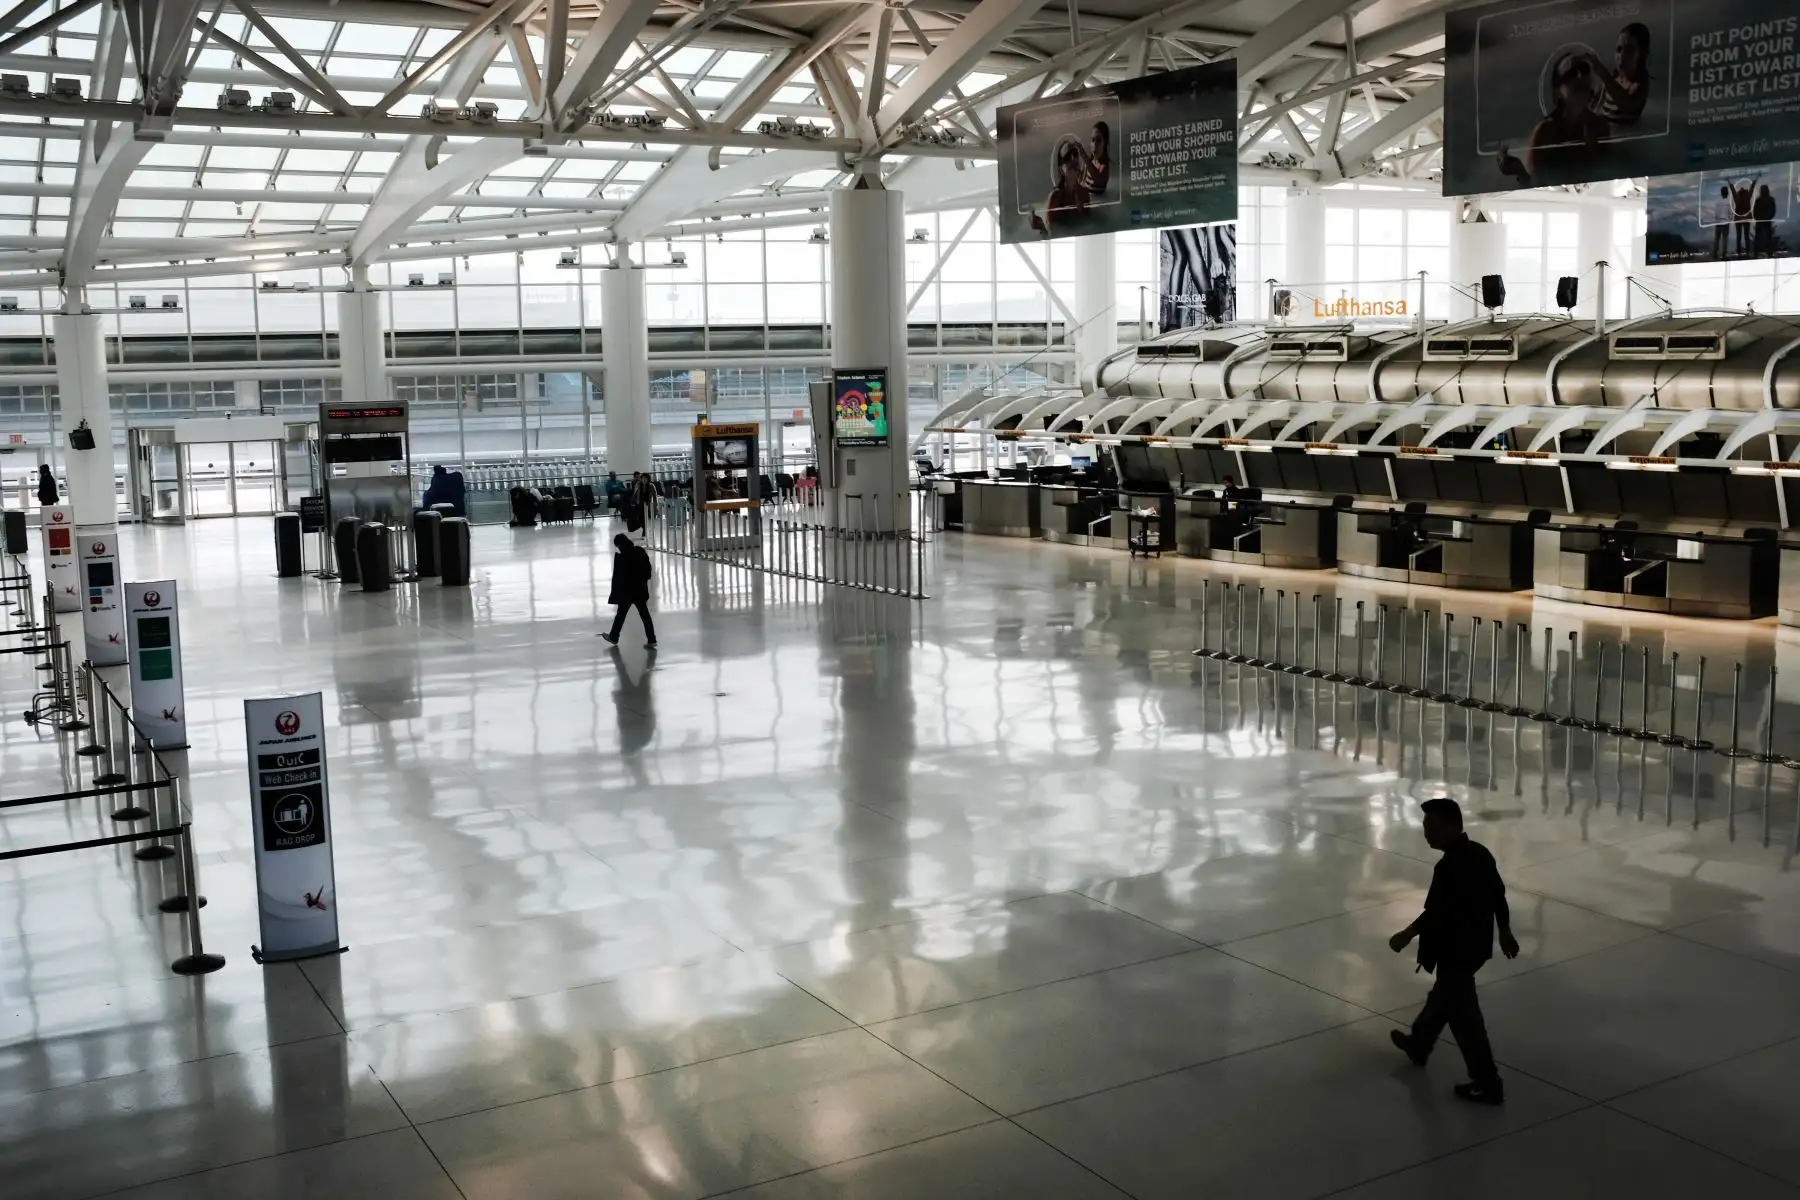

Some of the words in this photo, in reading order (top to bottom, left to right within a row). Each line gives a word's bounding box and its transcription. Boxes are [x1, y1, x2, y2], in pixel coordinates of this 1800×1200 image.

[1691, 30, 1724, 50] PUT
[1728, 16, 1798, 44] POINTS
[1690, 46, 1739, 68] FROM
[1744, 36, 1794, 58] YOUR
[1690, 65, 1727, 86] LIST
[1689, 79, 1758, 104] BUCKET
[1130, 131, 1148, 144] PUT
[1149, 125, 1183, 141] POINTS
[1185, 119, 1223, 135] EARNED
[1130, 144, 1155, 157] FROM
[1157, 139, 1182, 152] YOUR
[1184, 131, 1233, 148] SHOPPING
[1130, 157, 1149, 169] LIST
[1151, 151, 1189, 165] TOWARD
[1192, 147, 1217, 160] YOUR
[1130, 167, 1166, 181] BUCKET
[1167, 164, 1189, 176] LIST.
[1192, 293, 1207, 302] GAB
[1314, 297, 1407, 317] Lufthansa
[716, 426, 754, 435] Lufthansa
[265, 773, 282, 785] Web
[276, 837, 292, 847] BAG
[295, 833, 316, 844] DROP
